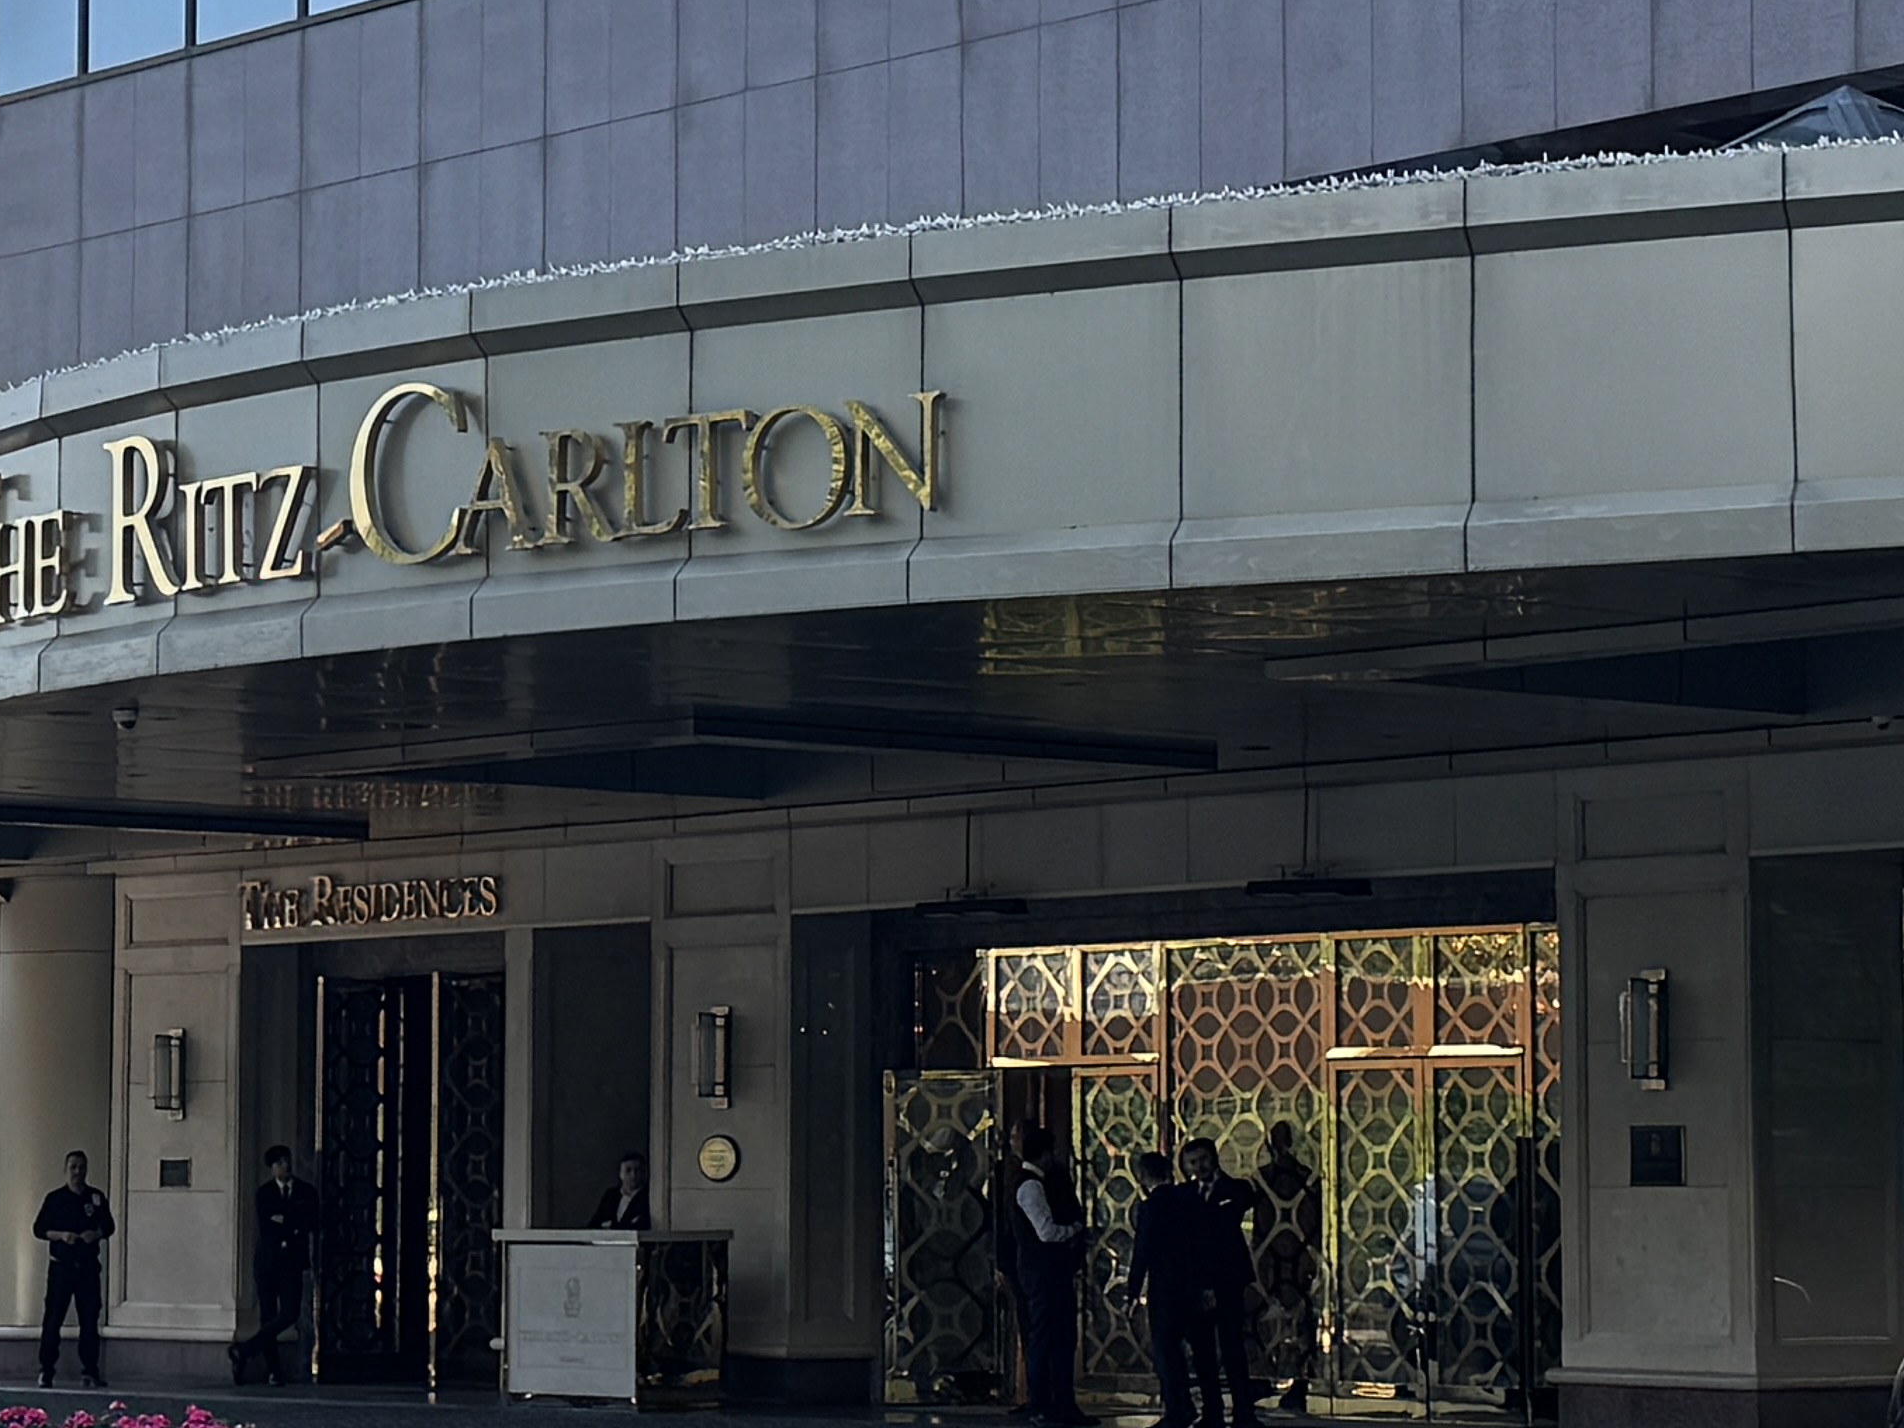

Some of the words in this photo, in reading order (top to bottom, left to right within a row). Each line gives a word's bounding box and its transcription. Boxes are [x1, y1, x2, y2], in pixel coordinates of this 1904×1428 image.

[102, 381, 946, 606] RITZ-CARLTON
[240, 880, 300, 931] THE
[309, 874, 498, 927] RESIDENCES
